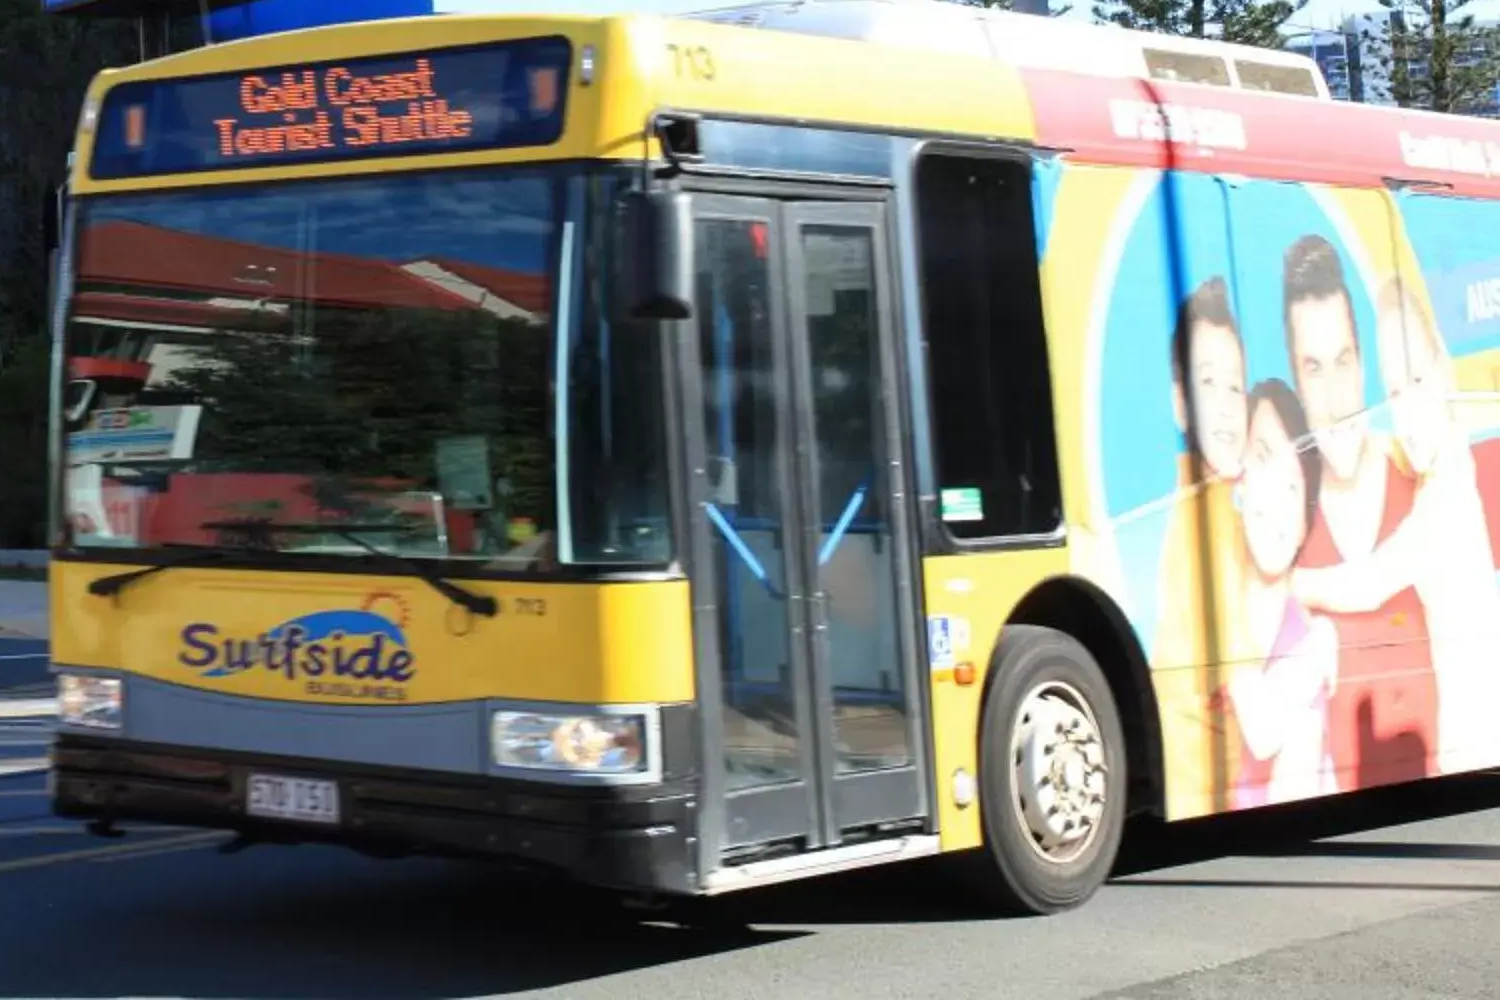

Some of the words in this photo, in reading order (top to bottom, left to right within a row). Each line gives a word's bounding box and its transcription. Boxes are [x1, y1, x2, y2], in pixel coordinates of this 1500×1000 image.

[240, 70, 318, 113] Gold
[324, 58, 436, 106] Coast
[665, 43, 716, 81] 713
[213, 110, 334, 156] Tourist
[343, 99, 473, 147] Shuttle
[178, 622, 416, 683] Surfside
